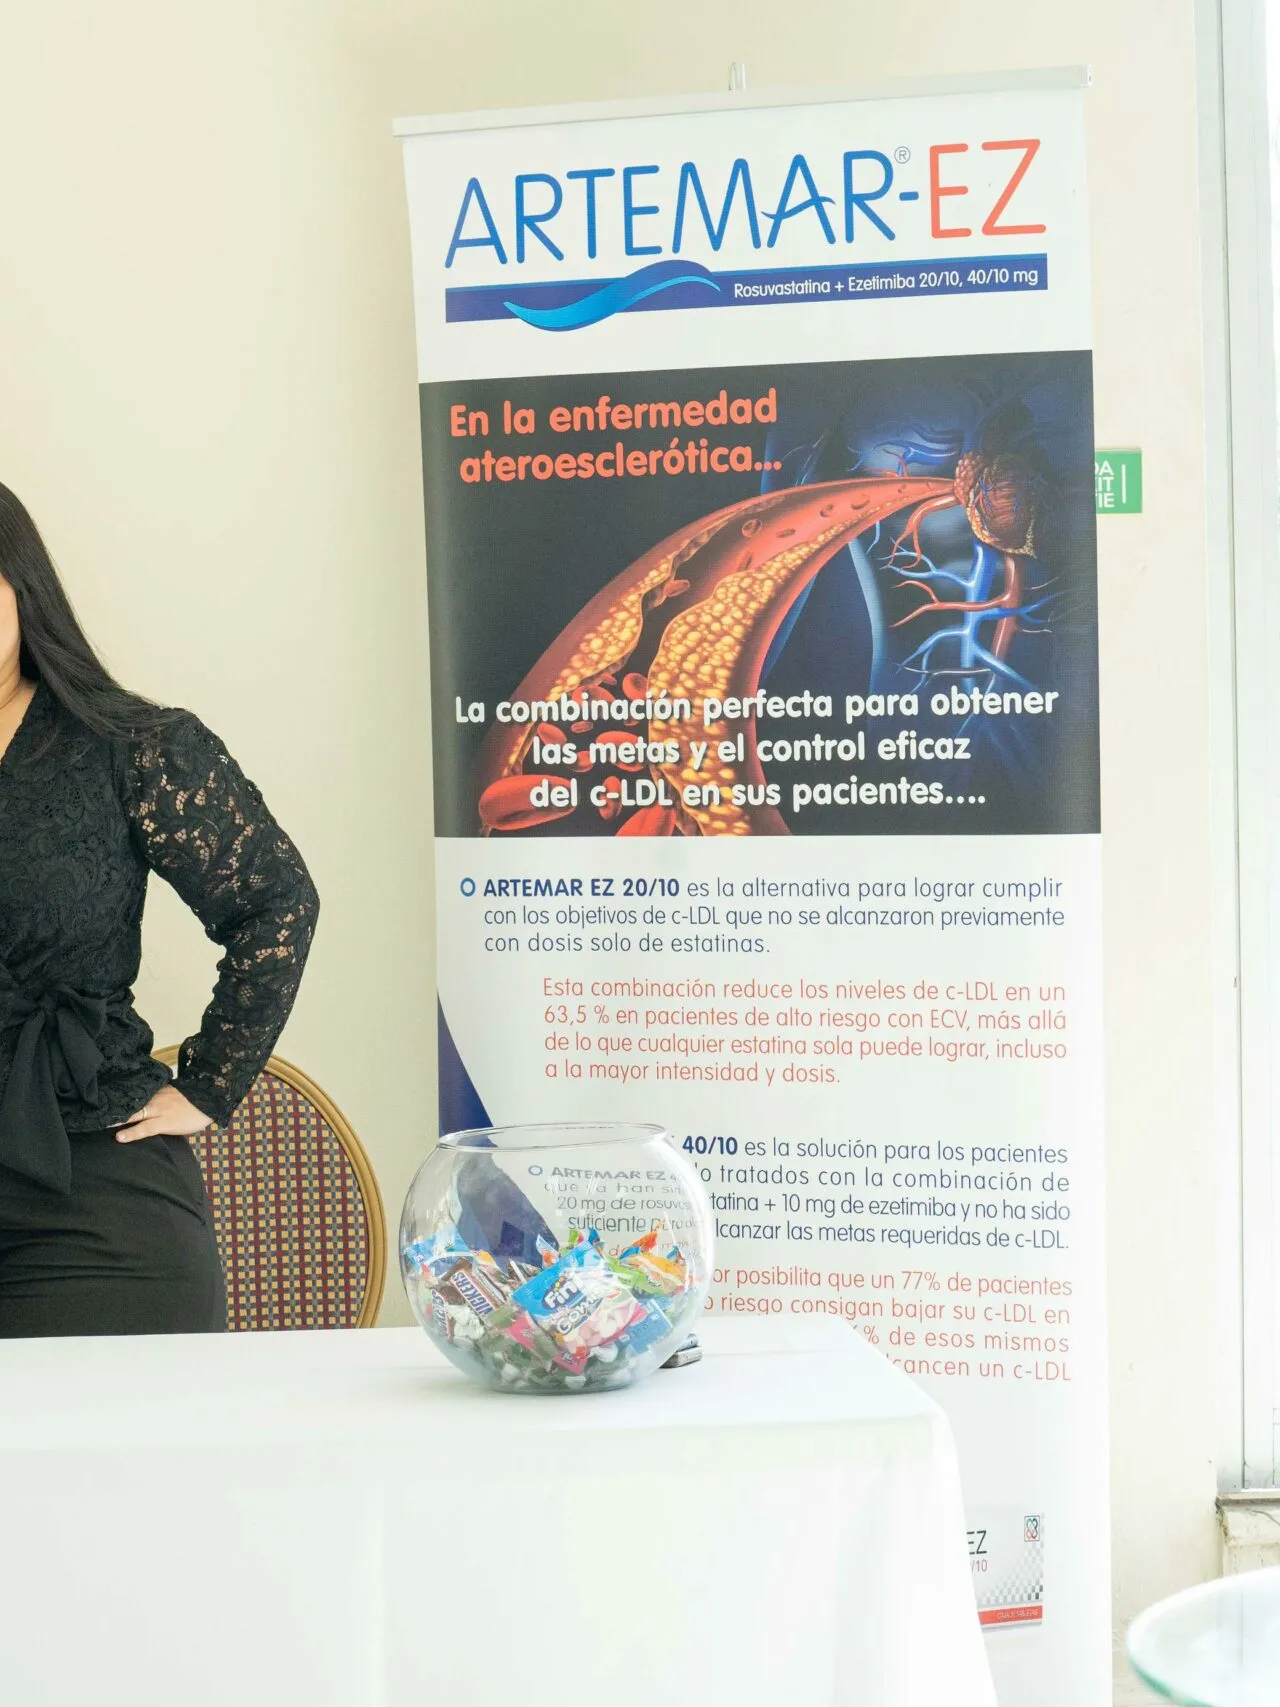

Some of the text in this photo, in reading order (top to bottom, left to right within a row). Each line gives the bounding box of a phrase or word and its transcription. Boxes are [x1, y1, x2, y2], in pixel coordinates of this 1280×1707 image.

[735, 269, 1037, 297] Rosuvastatina Ezetimiba 20/10, 40/10 mg
[451, 389, 776, 436] En la enfermedad
[460, 439, 783, 483] ateroesclerótica...
[456, 686, 1058, 725] La combinación perfecta para obtener
[534, 731, 970, 764] las metas el control eficaz
[531, 779, 577, 806] del
[591, 779, 672, 806] c-LDL
[683, 785, 719, 805] en
[732, 784, 780, 805] sus
[483, 877, 1063, 903] ARTEMAR EZ 20/10 es la alternativa para lograr cumplir
[484, 905, 1064, 930] con los objetivos de c-LDL que no se alcanzaron previamente
[485, 932, 770, 953] con dosis solo de estatinas.
[544, 977, 1065, 1001] Esta combinación reduce los niveles de c-LDL en un
[544, 1004, 1066, 1032] 63,5 % en pacientes de alto riesgo con ECV, más allá
[545, 1031, 1066, 1062] de lo que cualquier estatina sola puede lograr, incluso
[566, 1058, 840, 1084] la mayor intensidad dosis.
[682, 1135, 1068, 1166] 40/10 es la solución para los pacientes
[551, 1166, 641, 1180] ARTEMAR
[720, 1164, 1069, 1192] tratados con la combinación de
[868, 1196, 1070, 1220] ezetimiba sido
[568, 1216, 646, 1232] suficiente
[787, 1220, 1069, 1248] las metas requeridas de c-LDL.
[737, 1266, 1072, 1297] posibilita que un 77% de pacientes
[721, 1293, 1069, 1324] riesgo consigan bajar su c-LDL en
[889, 1326, 1069, 1352] de esos mismos
[980, 1361, 1070, 1380] un c-LDL
